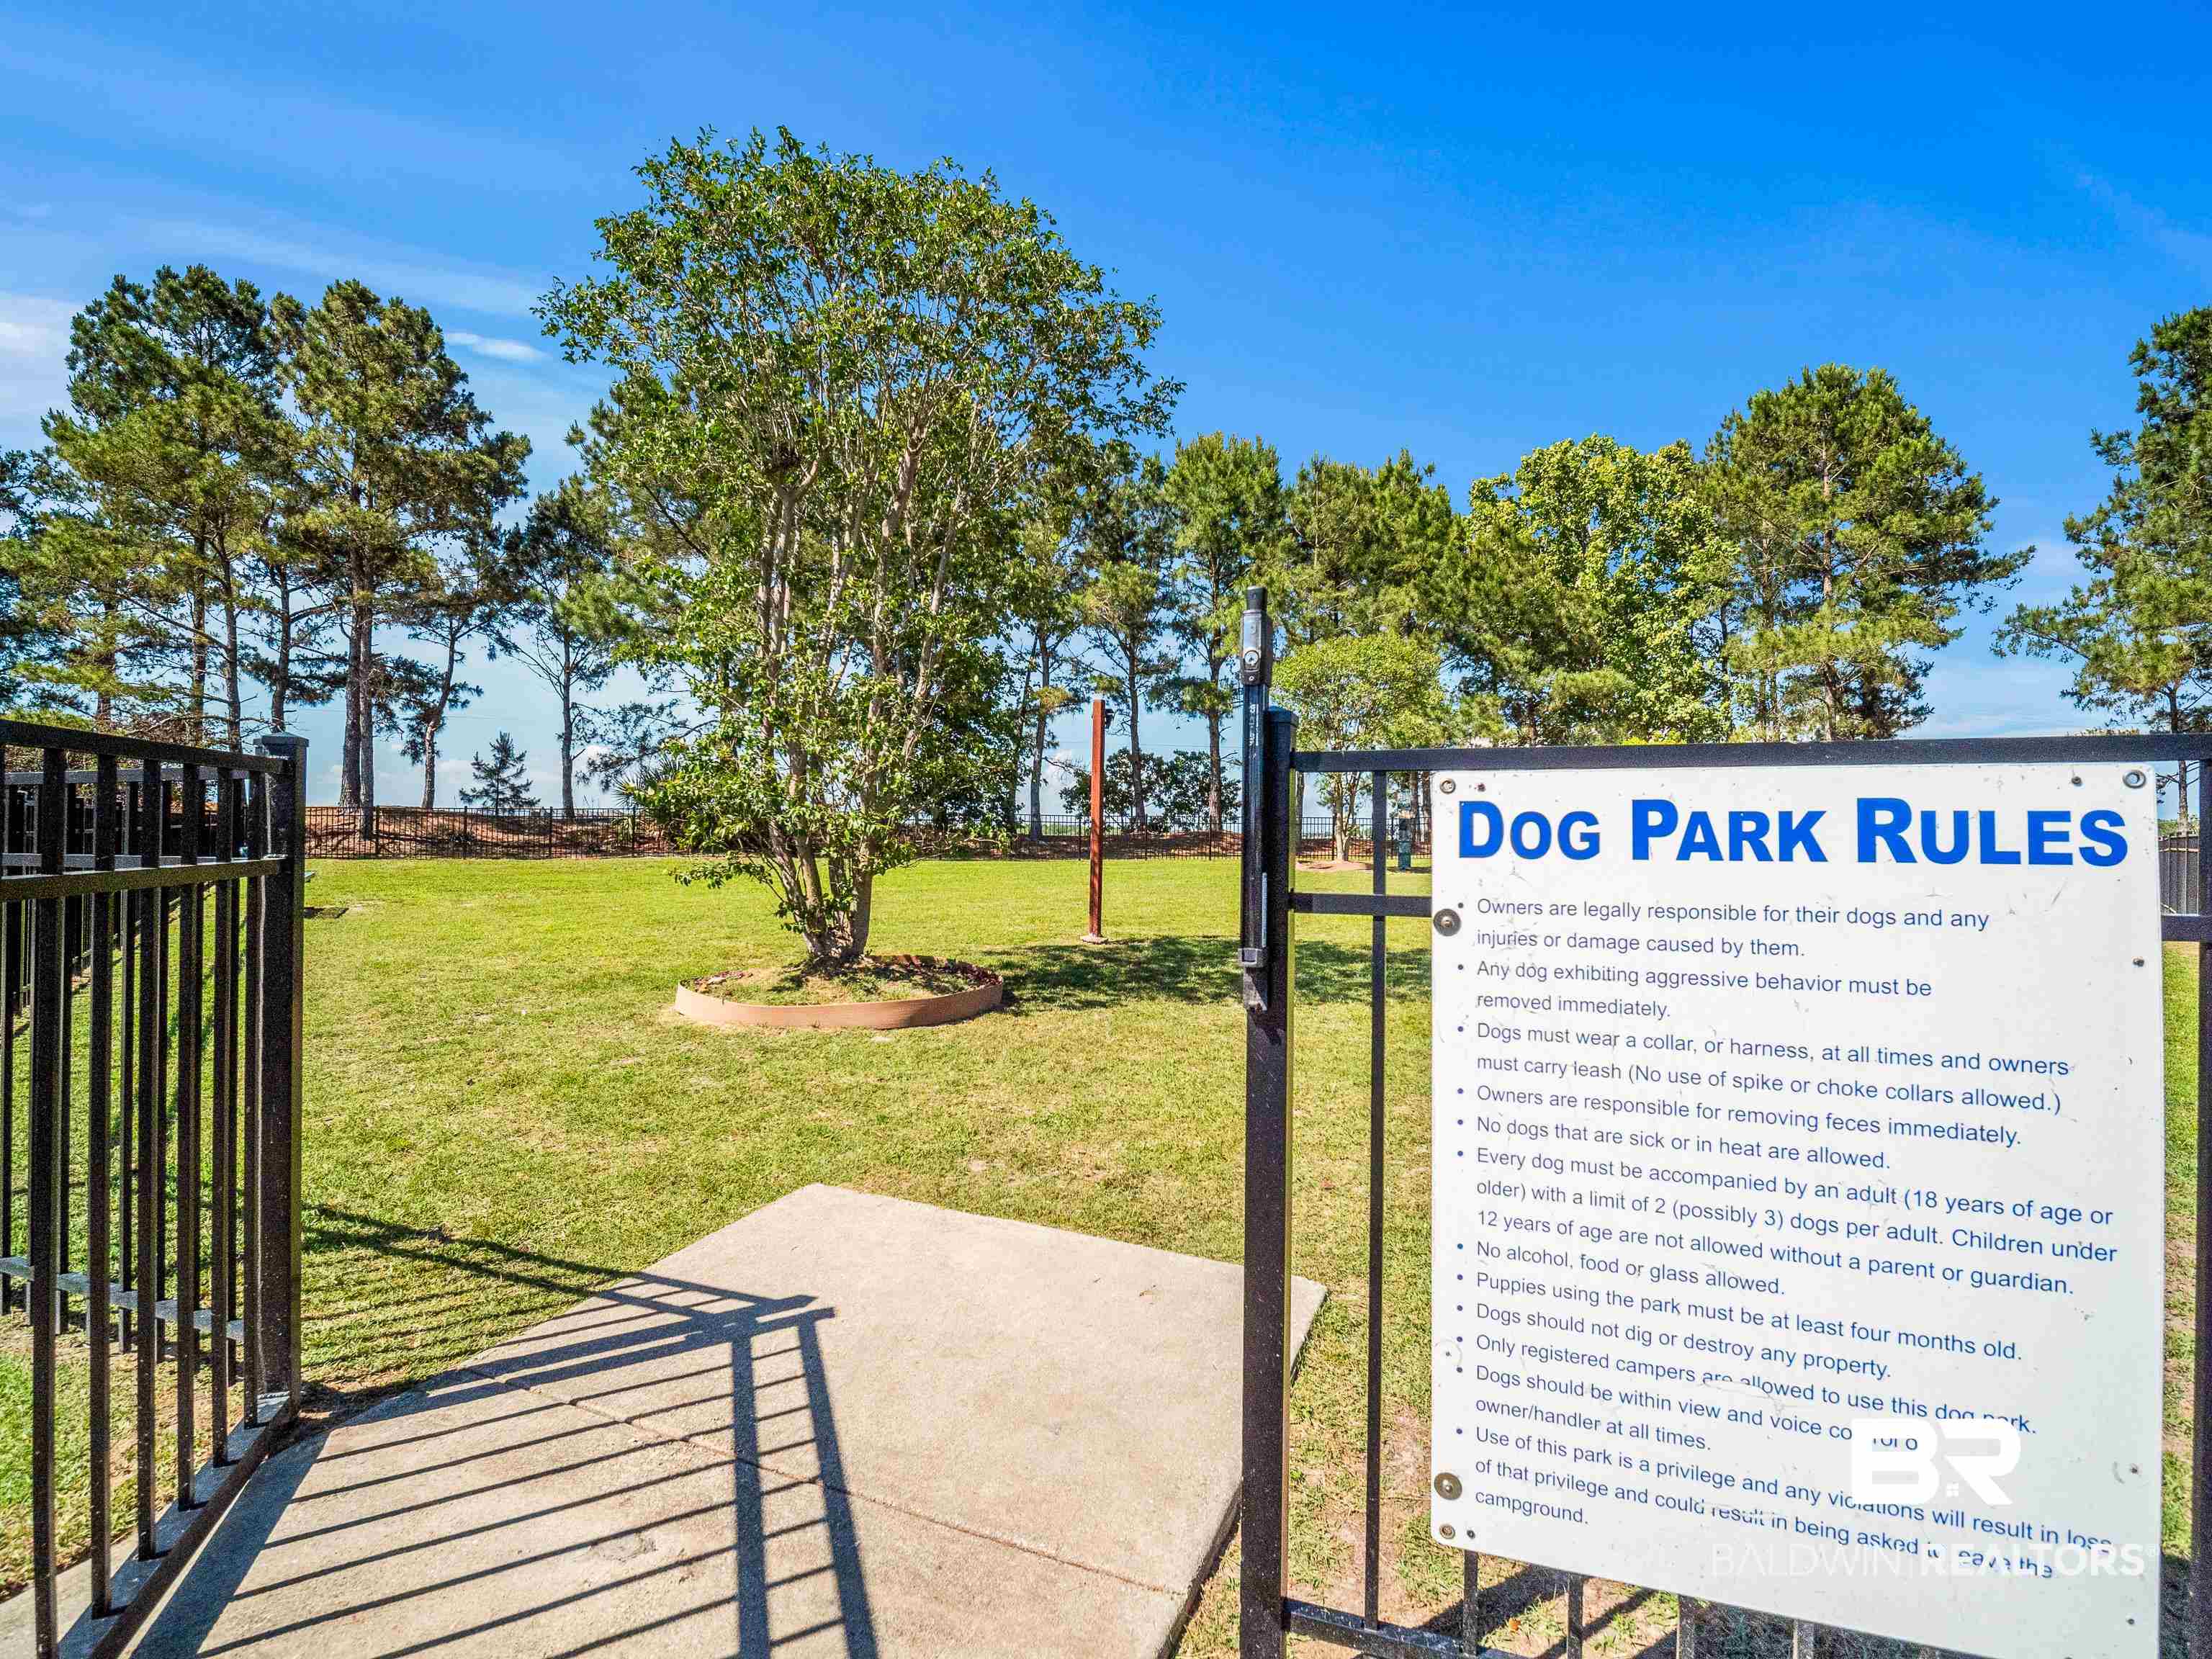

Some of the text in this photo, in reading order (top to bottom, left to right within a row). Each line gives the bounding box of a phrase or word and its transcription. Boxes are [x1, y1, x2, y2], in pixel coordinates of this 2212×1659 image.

[1460, 798, 2128, 867] DOG PARK RULES
[1477, 898, 1990, 932] Owners are legally responsible for their dogs and any
[1478, 929, 1804, 958] injuries or damage caused by them.
[1476, 961, 1932, 997] Any dog exhibiting aggressive behavior must be
[1478, 995, 1671, 1021] removed immediately.
[1478, 1022, 2069, 1076] Dogs must wear a collar, or harness, at all times and owners
[1477, 1084, 2021, 1148] Owners are responsible for removing feces immediately.
[1478, 1057, 2061, 1116] must carry leash (No use of spike or choke collars allowed.)
[1477, 1116, 1890, 1169] No dogs that are sick or in heat are allowed.
[1478, 1146, 2113, 1226] Every dog must be accompanied by an adult (18 years of age or
[1477, 1179, 2118, 1262] older) with a limit of 2 (possibly 3) dogs per adult. Children under
[1477, 1241, 1784, 1295] No alcohol, food or glass allowed.
[1478, 1210, 2073, 1295] 12 years of age are not allowed without a parent or guardian.
[1477, 1272, 2021, 1360] Puppies using the park must be at least four months old.
[1477, 1303, 1891, 1381] Dogs should not dig or destroy any property.
[1476, 1334, 1928, 1418] Only registered campers to use this
[1476, 1364, 1822, 1435] Dogs should be within view and voice
[1475, 1399, 1711, 1450] owner/handler at all times.
[1475, 1491, 1588, 1524] campground.
